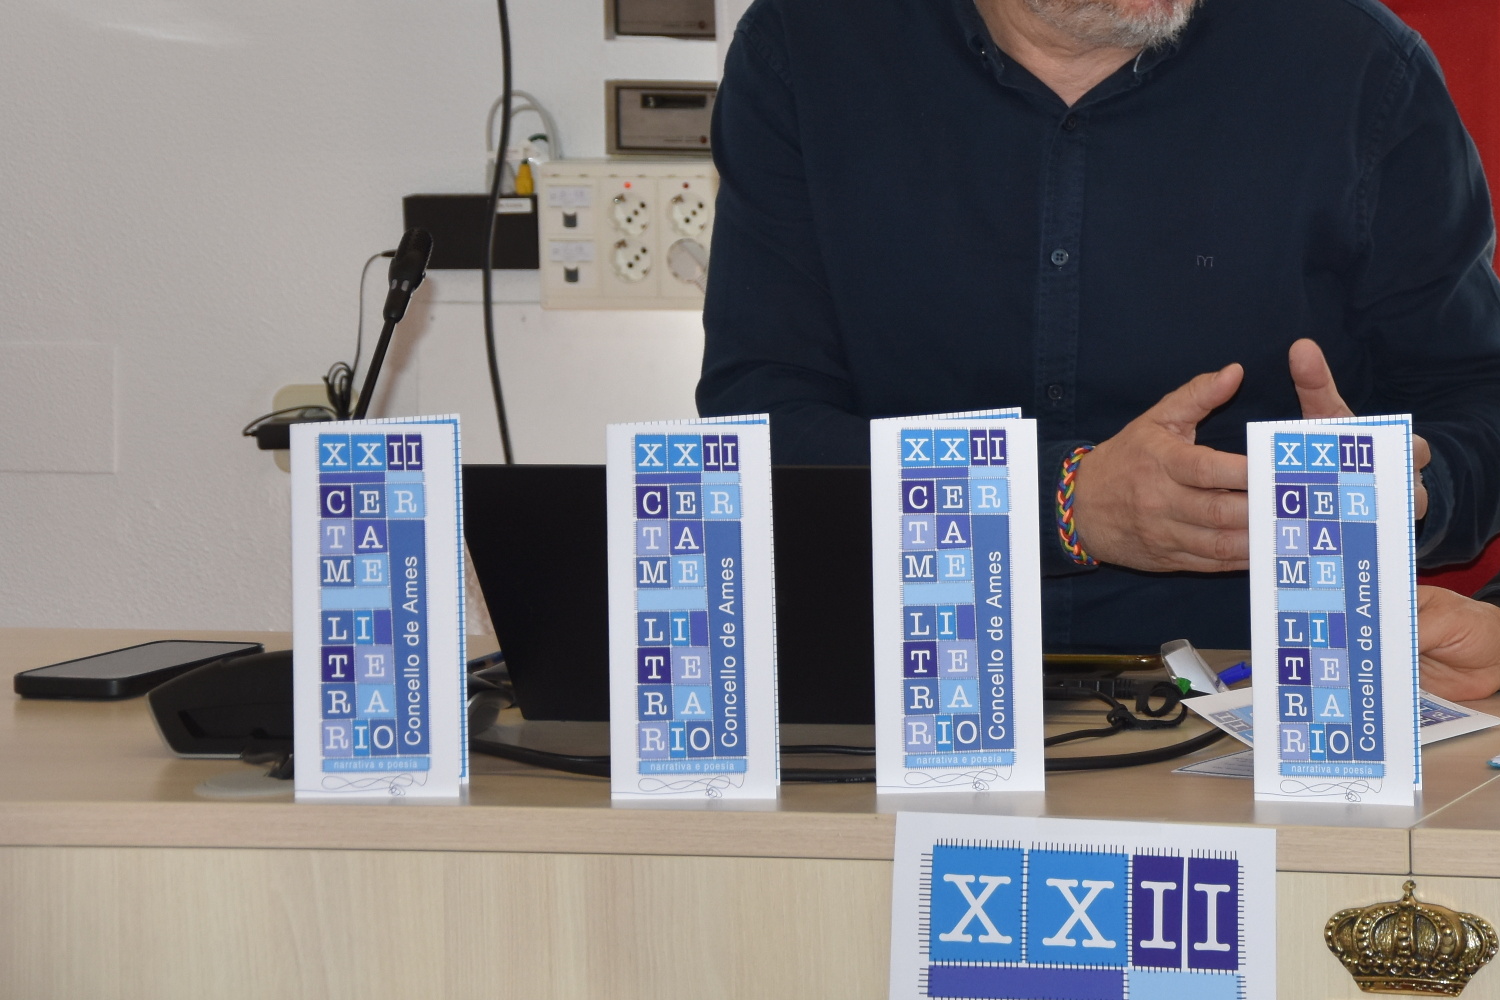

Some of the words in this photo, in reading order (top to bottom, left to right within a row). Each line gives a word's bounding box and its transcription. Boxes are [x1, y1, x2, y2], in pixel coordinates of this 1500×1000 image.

[322, 443, 420, 466] XXII
[639, 443, 736, 466] XXII
[904, 437, 1004, 461] XXII
[1278, 443, 1371, 467] XXII
[326, 490, 417, 513] CER
[642, 491, 733, 515] CER
[908, 485, 1000, 509] CER
[1282, 490, 1368, 515] CER
[327, 526, 383, 549] TA
[643, 527, 699, 550] TA
[909, 520, 966, 544] TA
[1282, 526, 1337, 551] TA
[323, 559, 383, 583] ME
[639, 560, 698, 584] ME
[905, 554, 965, 578] ME
[1279, 560, 1337, 584] ME
[402, 556, 418, 613] Ames
[719, 557, 734, 615] Ames
[986, 551, 1002, 608] Ames
[1356, 560, 1370, 618] Ames
[328, 617, 369, 640] LI
[403, 621, 420, 645] de
[644, 619, 685, 641] LI
[720, 623, 735, 648] de
[910, 612, 953, 635] LI
[987, 616, 1003, 641] de
[1284, 619, 1325, 642] LI
[1357, 626, 1373, 651] de
[328, 654, 385, 678] TE
[644, 655, 700, 679] TE
[911, 649, 967, 673] TE
[1285, 657, 1340, 681] TE
[327, 690, 388, 713] RA
[404, 655, 422, 746] Concello
[644, 692, 705, 715] RA
[721, 656, 738, 747] Concello
[911, 685, 972, 708] RA
[988, 649, 1005, 740] Concello
[1285, 693, 1343, 717] RA
[1357, 659, 1376, 751] Concello
[325, 726, 394, 749] RIO
[642, 727, 710, 751] RIO
[908, 721, 977, 744] RIO
[1283, 729, 1349, 754] RIO
[651, 762, 691, 771] narrativa
[917, 756, 958, 764] narrativa
[1291, 765, 1331, 773] narrativa
[938, 873, 1231, 952] XXII
